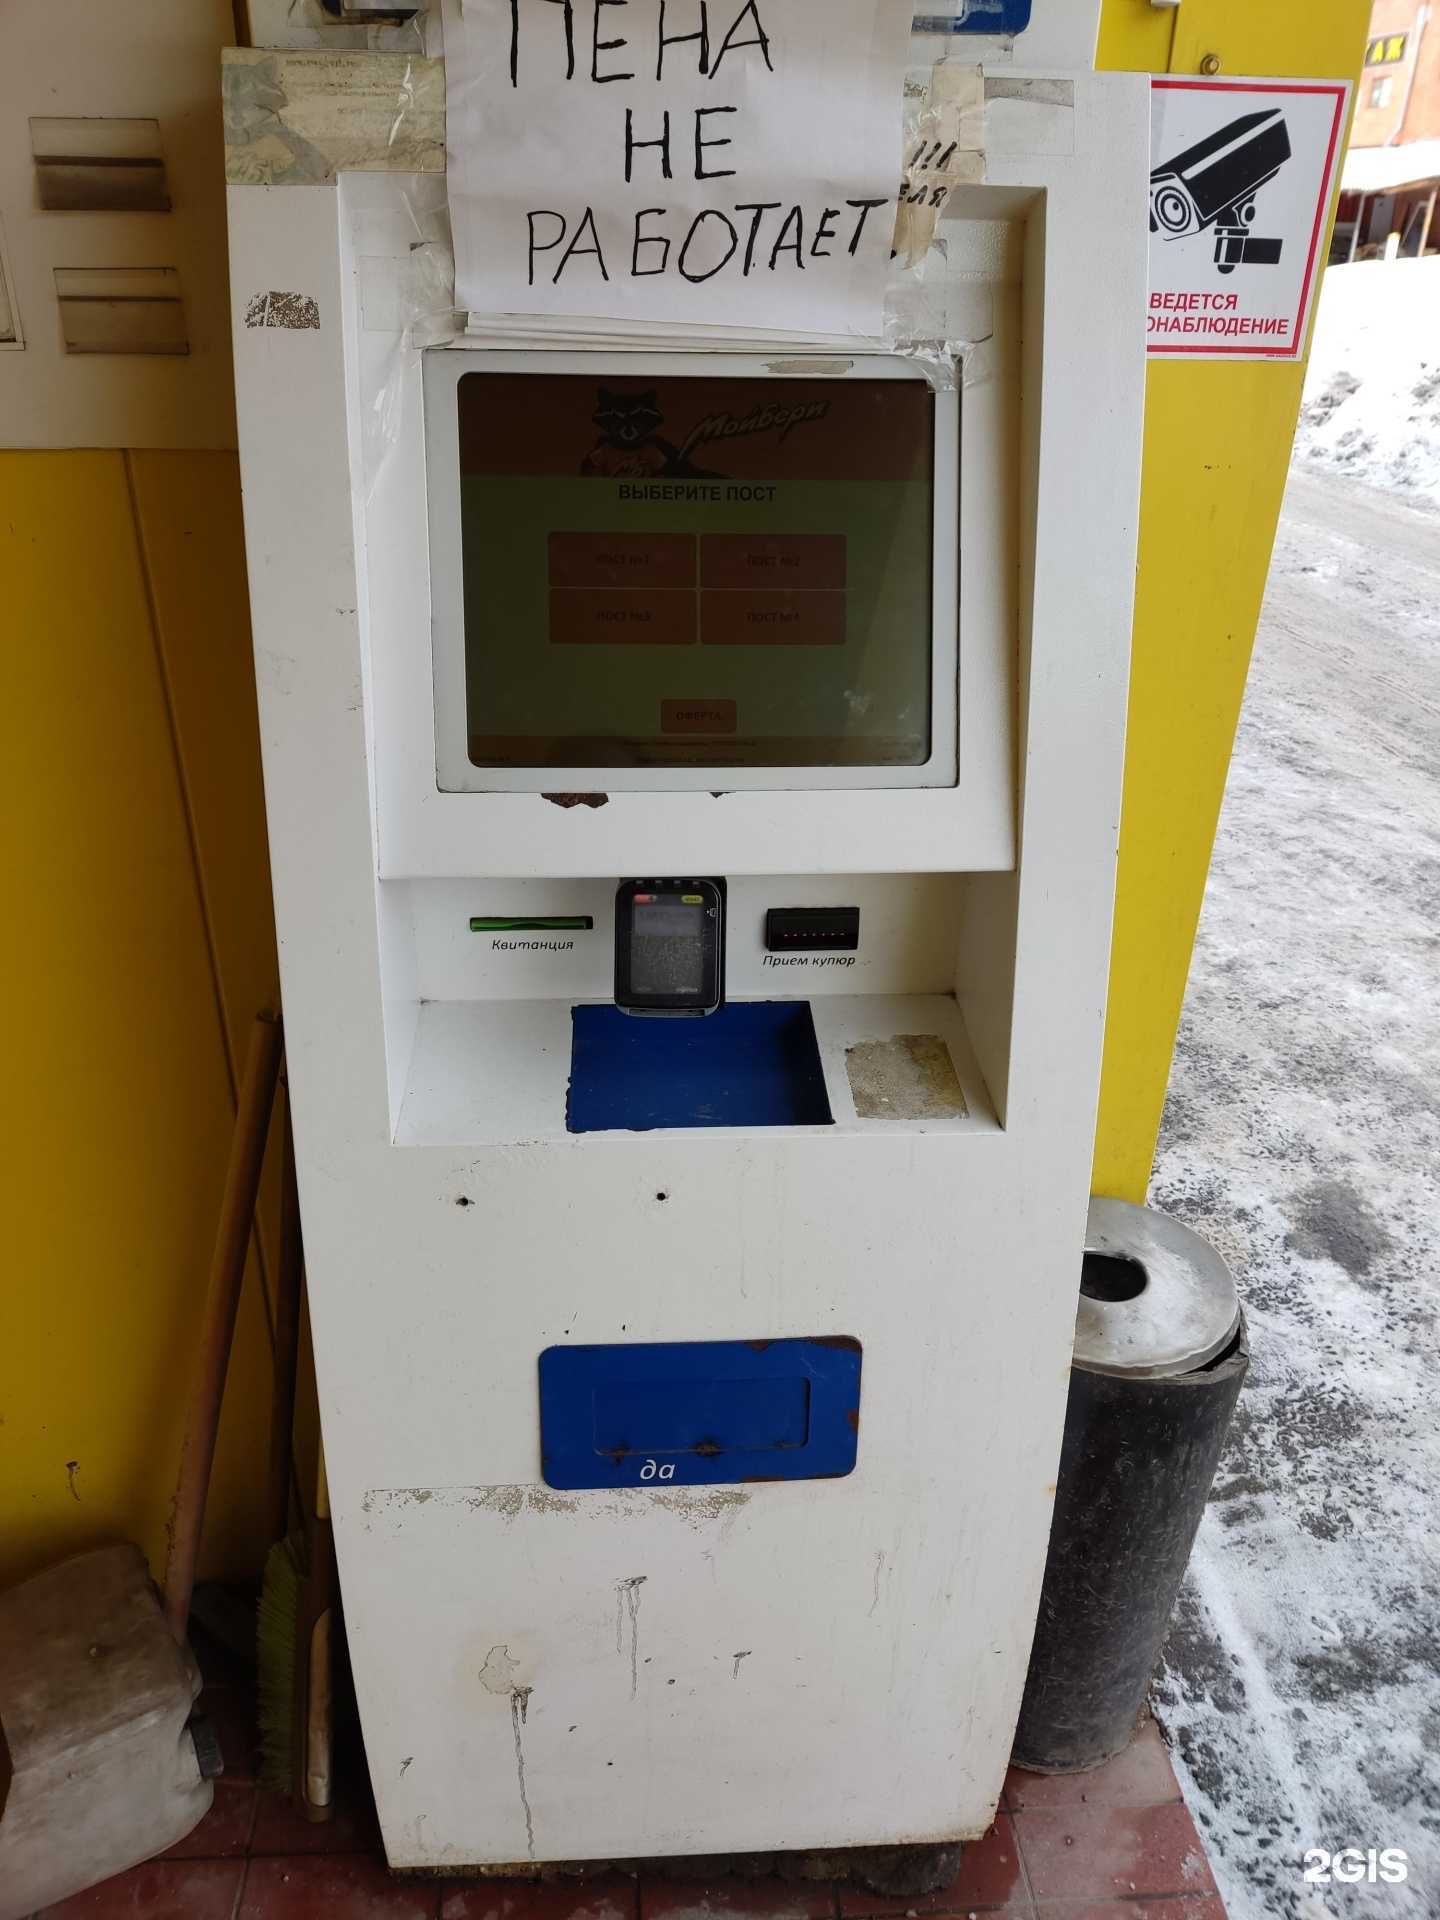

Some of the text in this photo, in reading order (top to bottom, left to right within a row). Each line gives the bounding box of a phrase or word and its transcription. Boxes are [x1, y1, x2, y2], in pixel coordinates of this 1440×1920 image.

[510, 0, 773, 88] ПЕНА
[625, 106, 737, 183] НЕ
[1149, 292, 1239, 312] ВЕДЕТСЯ
[618, 483, 777, 502] ВЫБЕРИТЕ ПОСТ
[675, 711, 722, 721] ОФЕРТА
[491, 938, 574, 952] Квитанция
[763, 954, 856, 968] Прием купюр
[639, 1458, 676, 1481] да
